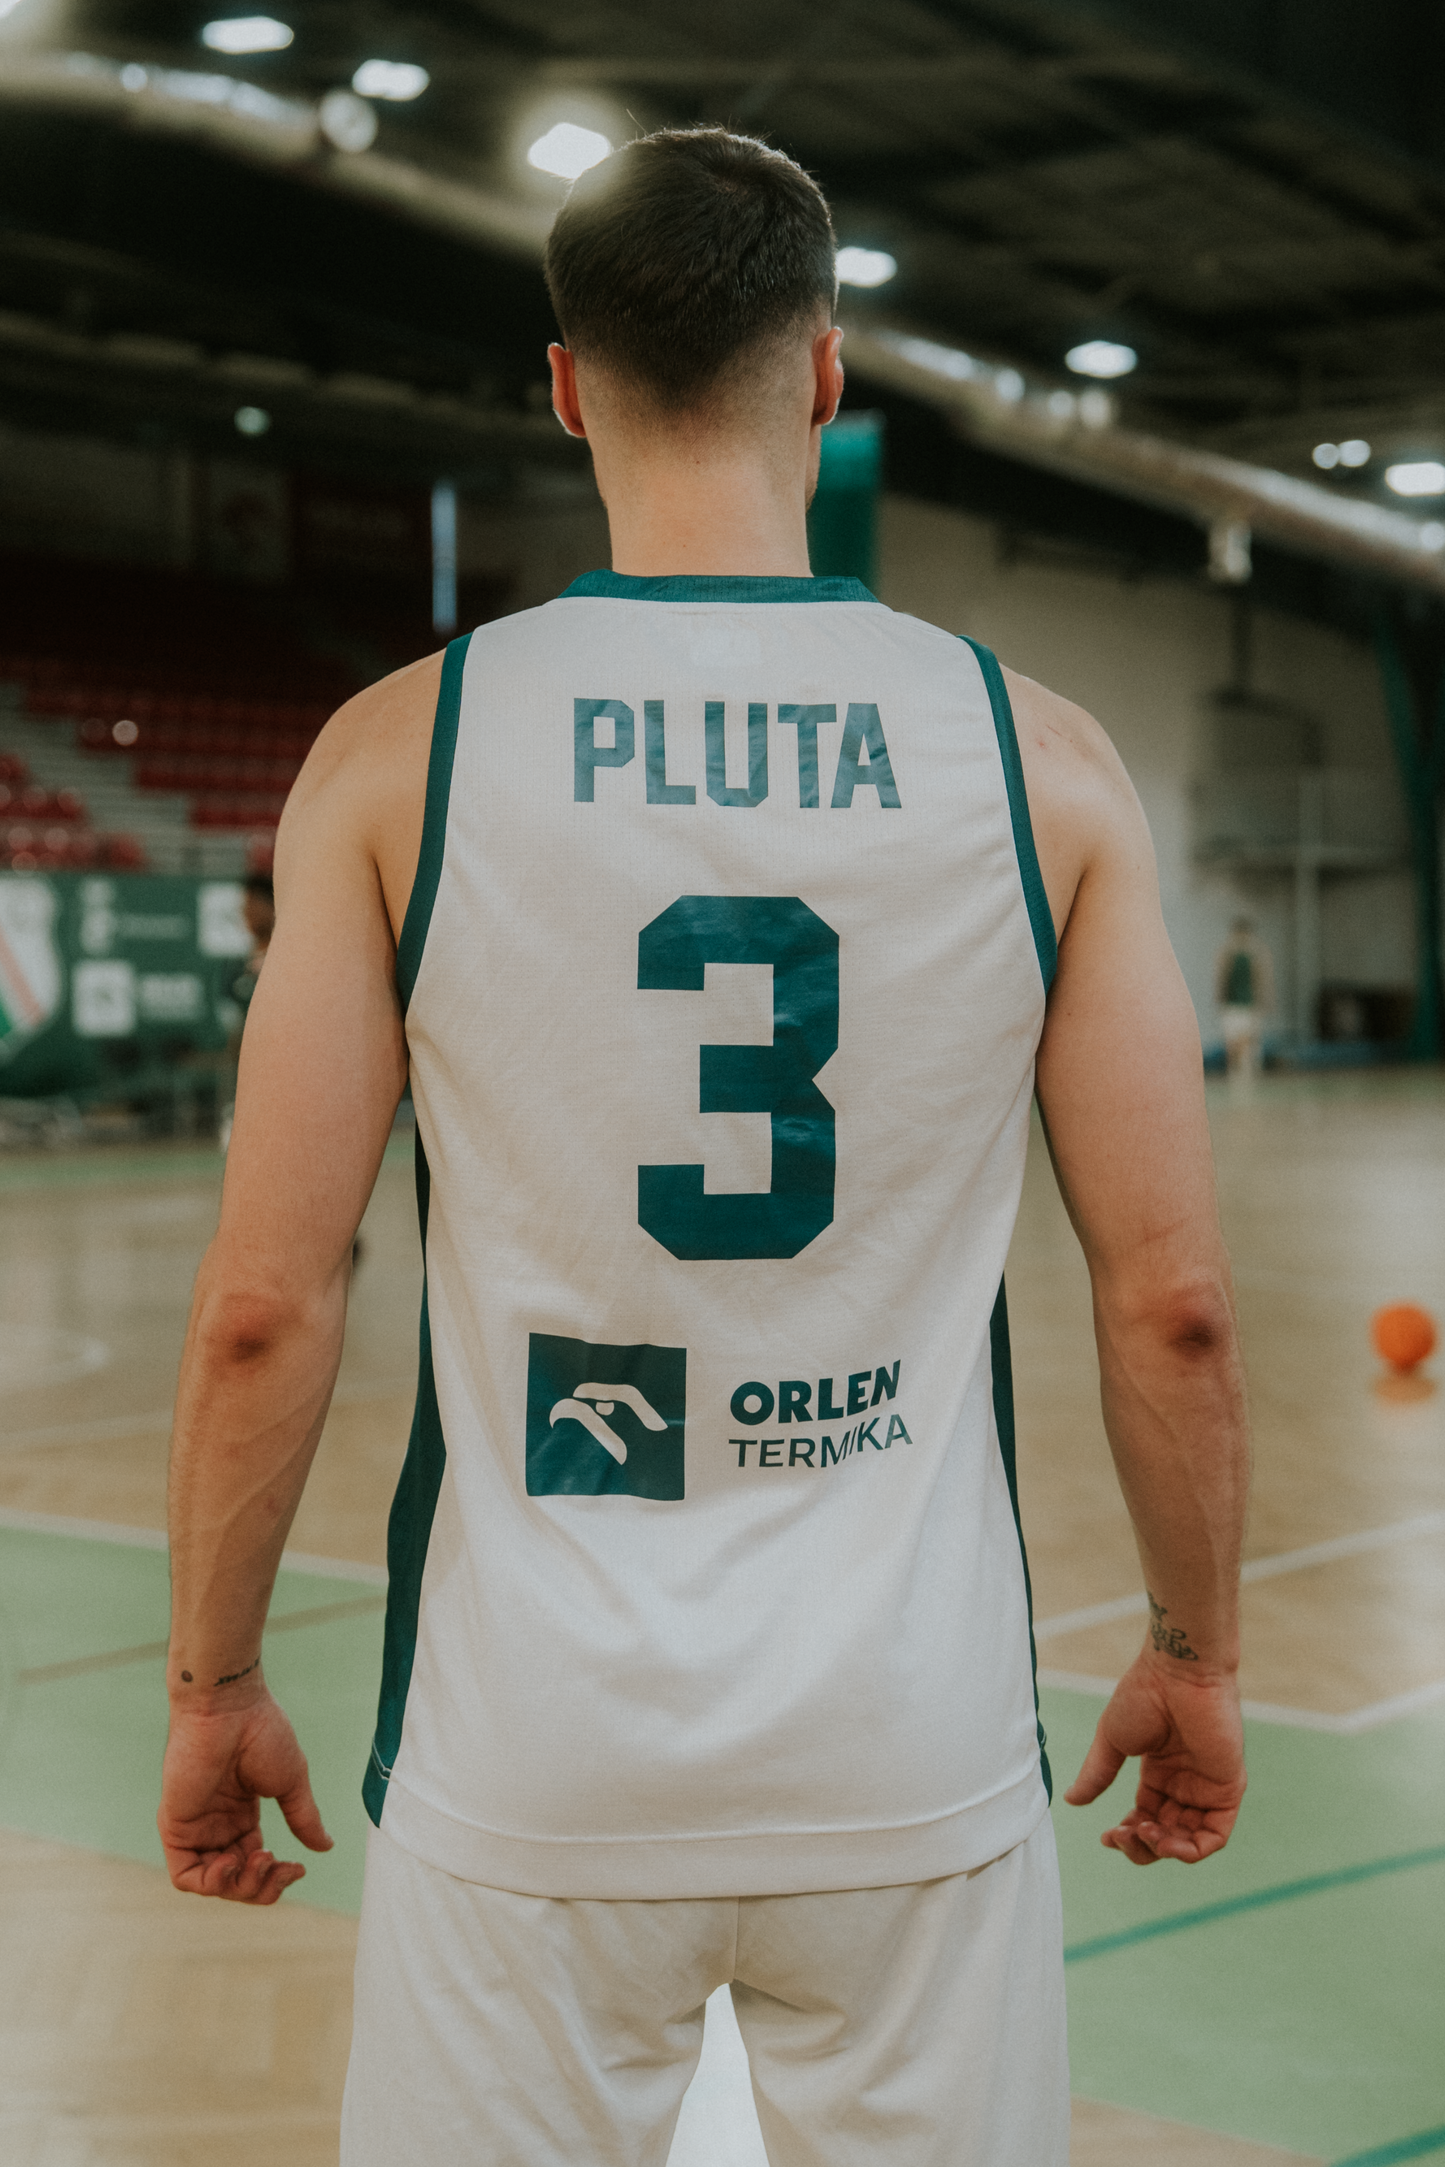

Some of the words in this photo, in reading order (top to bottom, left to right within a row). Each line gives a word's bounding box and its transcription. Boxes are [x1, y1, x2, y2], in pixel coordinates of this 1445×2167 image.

[574, 698, 902, 809] PLUTA
[637, 896, 840, 1261] 3
[729, 1359, 901, 1426] ORLEN
[728, 1413, 913, 1468] TERMIKA
